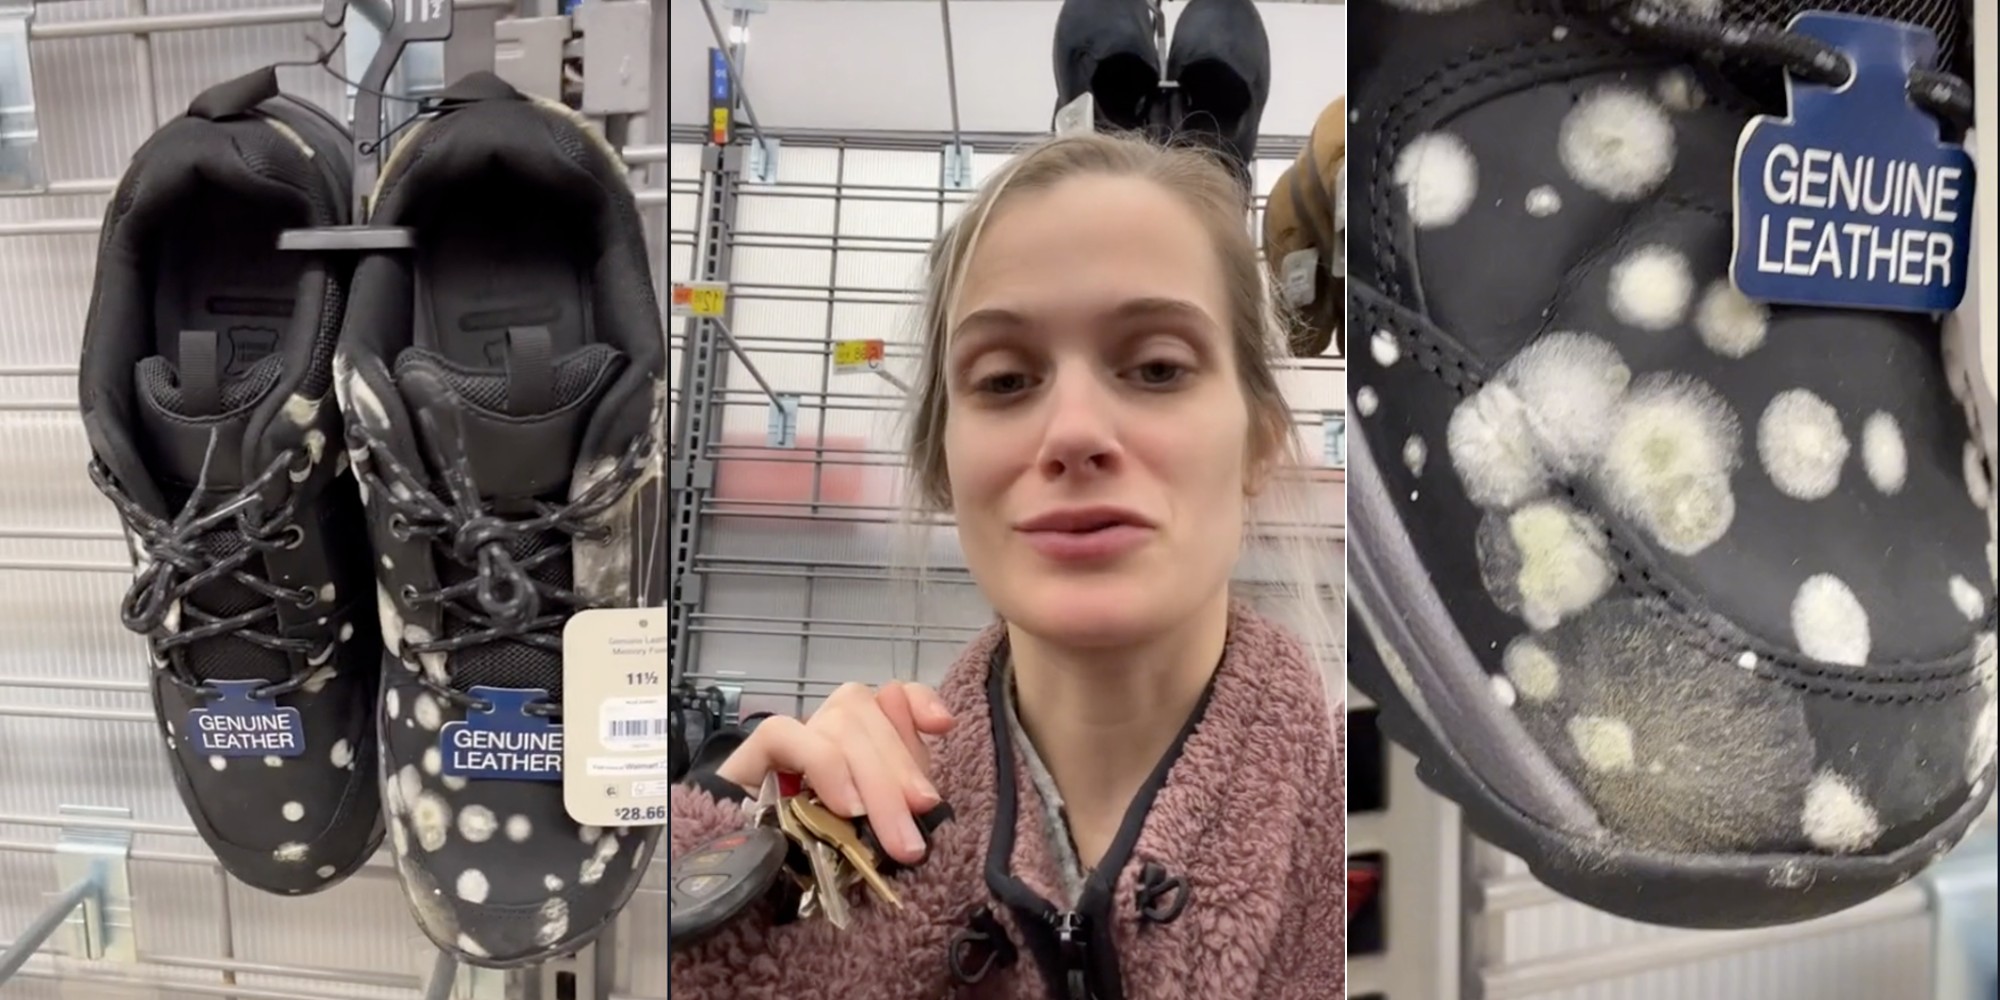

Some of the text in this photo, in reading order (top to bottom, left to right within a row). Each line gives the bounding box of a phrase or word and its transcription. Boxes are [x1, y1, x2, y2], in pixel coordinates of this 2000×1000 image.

[1762, 143, 1962, 223] GENUINE
[1757, 213, 1954, 288] LEATHER
[199, 713, 292, 732] GENUINE
[203, 732, 295, 750] LEATHER
[453, 730, 563, 751] GENUINE
[453, 751, 562, 772] LEATHER
[614, 804, 665, 821] $28.66
